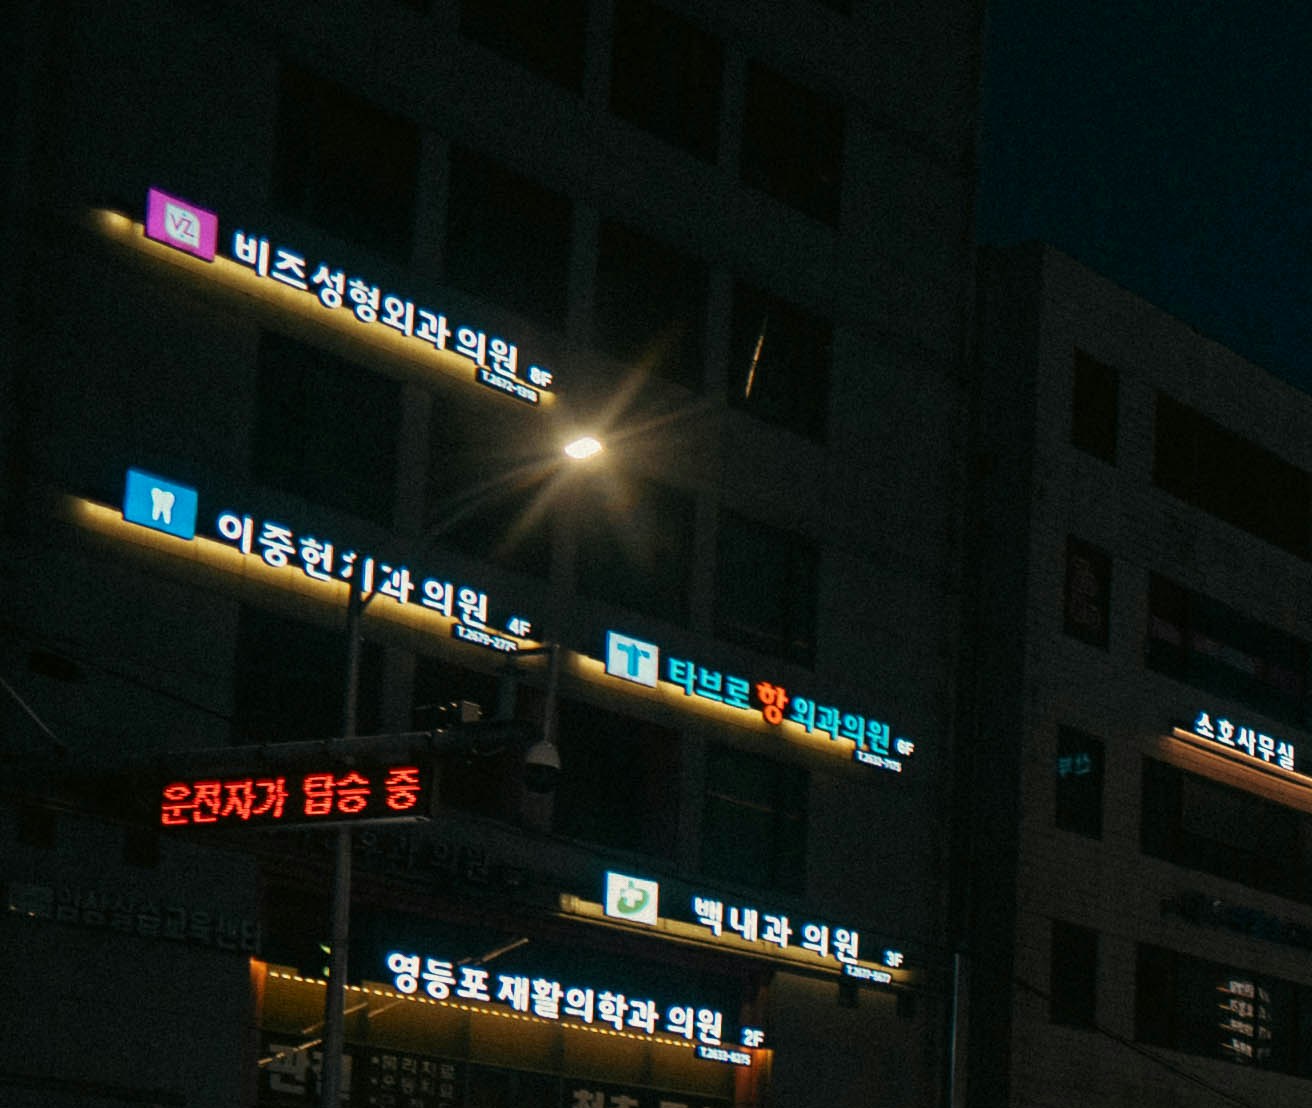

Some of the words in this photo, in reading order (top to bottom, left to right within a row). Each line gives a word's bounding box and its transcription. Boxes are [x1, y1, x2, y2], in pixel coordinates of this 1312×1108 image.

[232, 229, 452, 352] 비즈성형외과
[454, 326, 519, 380] 의원
[420, 576, 491, 632] 의원
[1194, 710, 1296, 772] 소호사무실
[160, 776, 289, 826] 운전자가
[302, 771, 371, 816] 탑승
[384, 766, 421, 811] 중
[691, 895, 793, 949] 백내과
[800, 923, 860, 966] 의원
[881, 949, 905, 968] 3F
[386, 951, 491, 1002] 영등포
[497, 974, 660, 1034] 재활의학과
[665, 1005, 722, 1046] 의원
[740, 1027, 766, 1049] 2F
